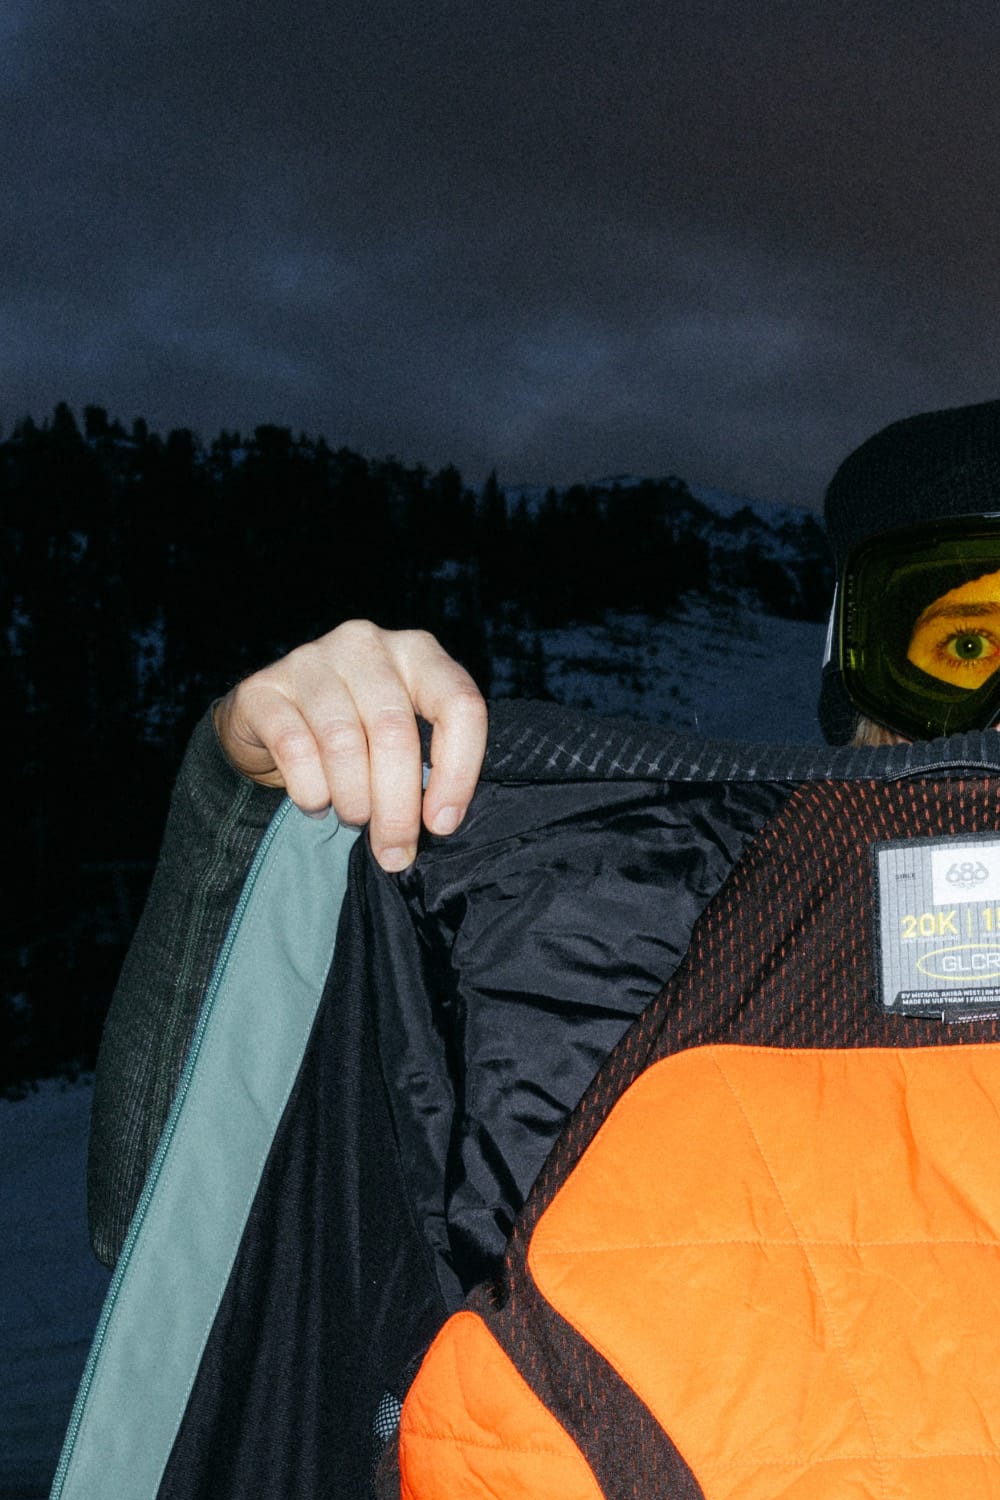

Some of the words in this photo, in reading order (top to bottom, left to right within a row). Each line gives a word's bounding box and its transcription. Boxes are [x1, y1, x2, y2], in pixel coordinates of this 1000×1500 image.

[945, 861, 989, 884] 686
[902, 910, 959, 938] 20K
[942, 953, 1000, 972] GLCR
[931, 996, 965, 1004] VIETNAM
[964, 988, 982, 996] WEST
